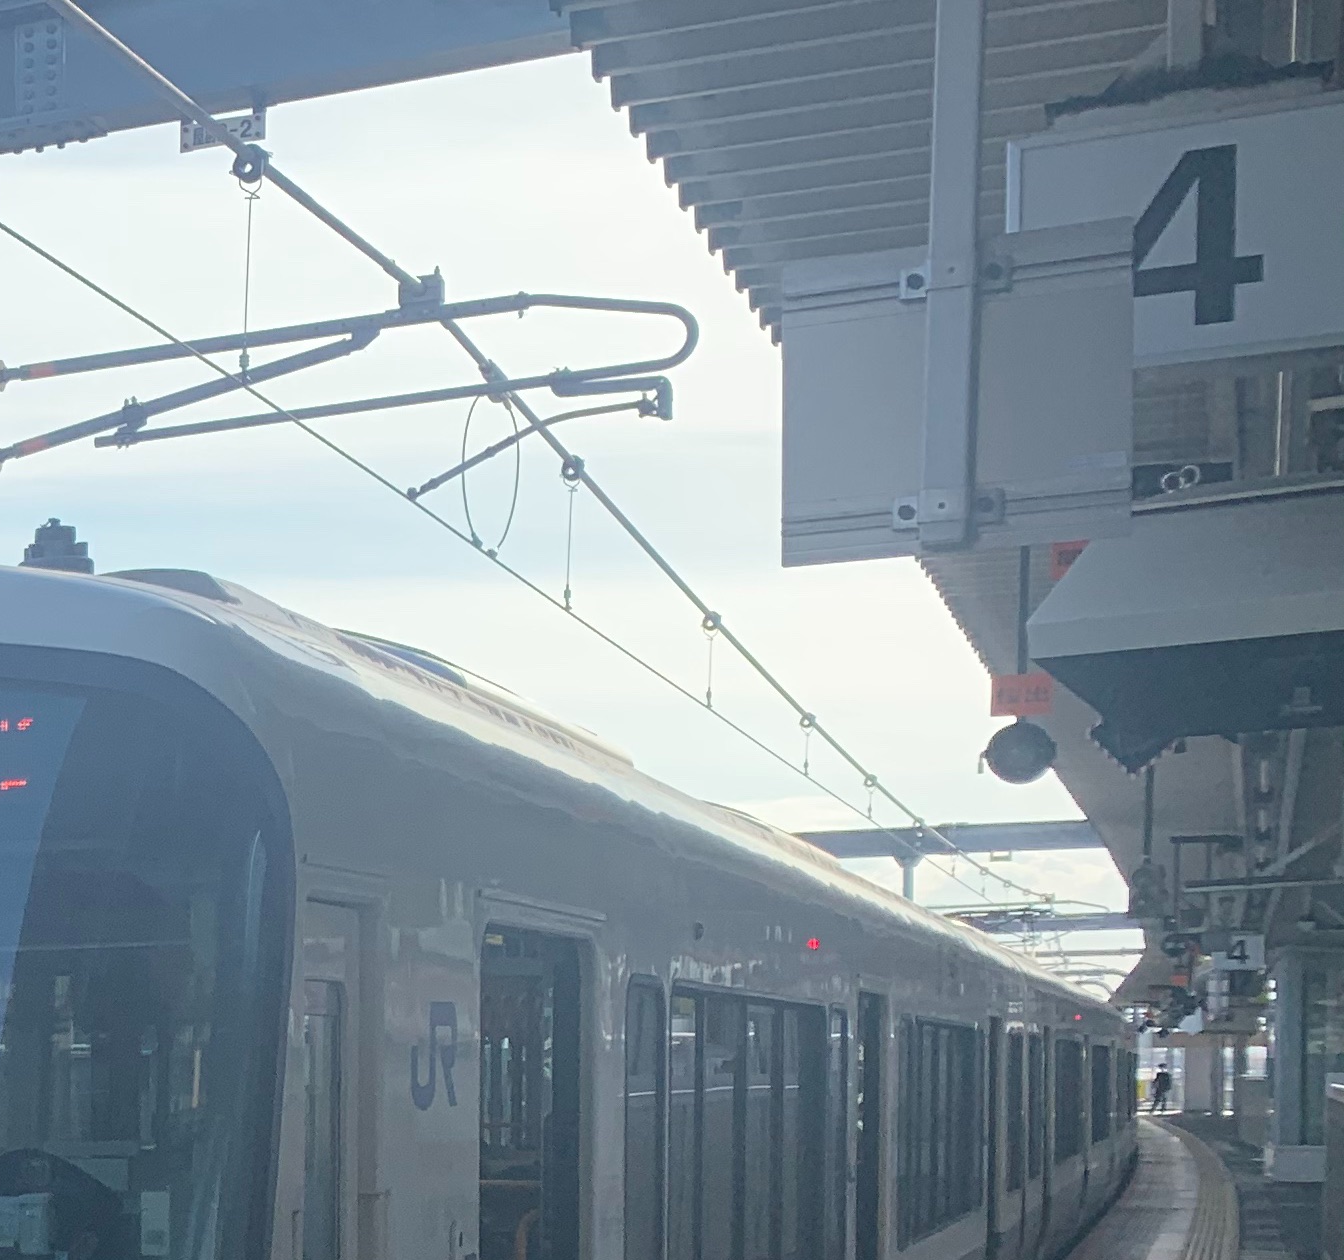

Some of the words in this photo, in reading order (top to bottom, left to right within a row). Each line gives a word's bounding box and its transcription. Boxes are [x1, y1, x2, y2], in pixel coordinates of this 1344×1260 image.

[1133, 144, 1265, 326] 4
[1227, 939, 1251, 964] 4
[411, 1001, 458, 1111] JR
